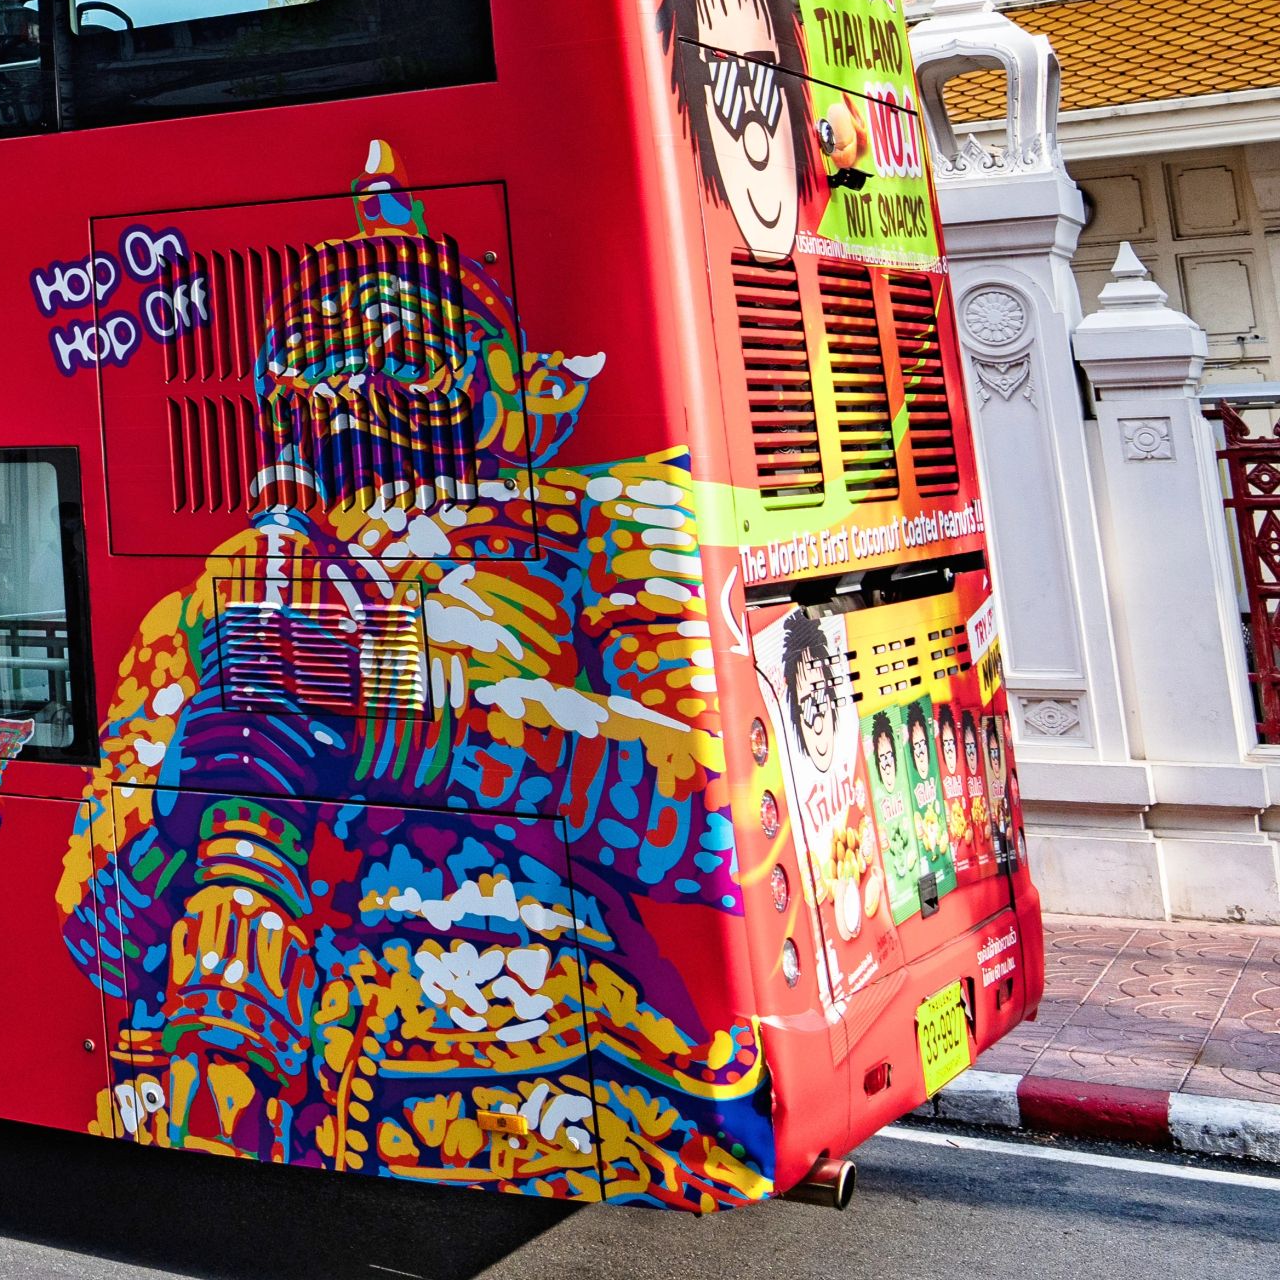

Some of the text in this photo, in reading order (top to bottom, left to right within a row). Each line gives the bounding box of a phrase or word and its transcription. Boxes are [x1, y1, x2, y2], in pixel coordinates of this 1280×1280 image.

[814, 7, 902, 75] THAILAND
[865, 83, 922, 176] NO.1
[844, 192, 928, 238] NUT SNACKS
[124, 230, 185, 278] On
[145, 275, 209, 337] Off
[739, 544, 767, 584] The
[768, 531, 819, 577] World's
[822, 528, 851, 566] First
[851, 519, 901, 559] Coconut
[902, 510, 939, 549] Coated
[974, 615, 988, 648] TRY
